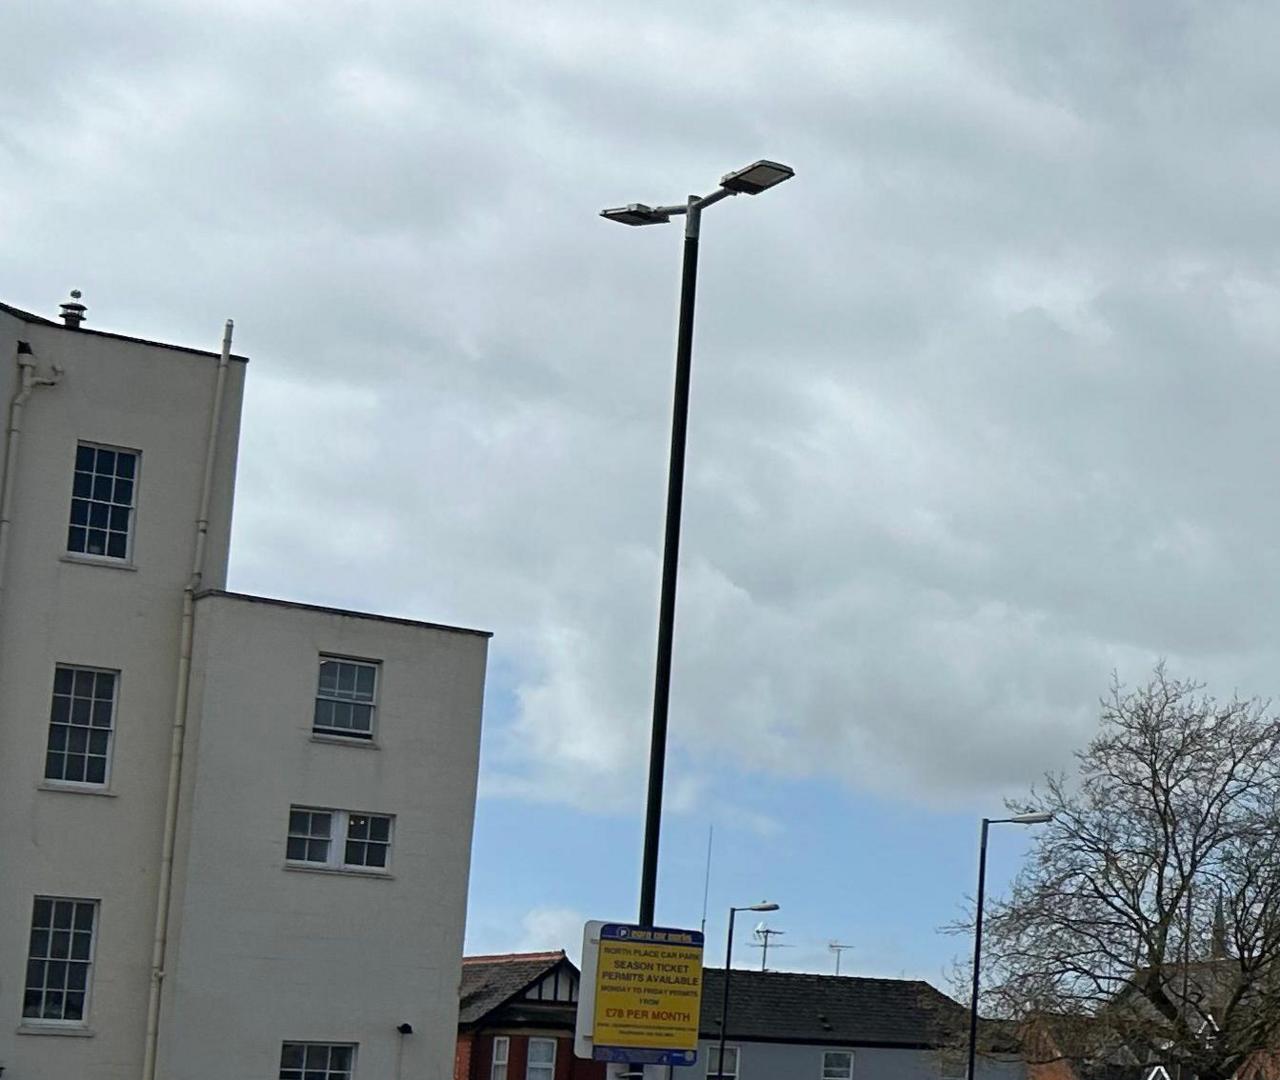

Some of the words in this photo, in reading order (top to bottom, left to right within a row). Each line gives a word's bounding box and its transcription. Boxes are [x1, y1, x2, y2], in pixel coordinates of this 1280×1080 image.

[633, 949, 659, 958] PLACE
[613, 960, 655, 971] SEASON
[656, 963, 689, 974] TICKET
[602, 971, 644, 983] PERMITS
[646, 975, 699, 986] AVAILABLE
[627, 1009, 649, 1019] PER
[651, 1011, 690, 1022] MONTH
